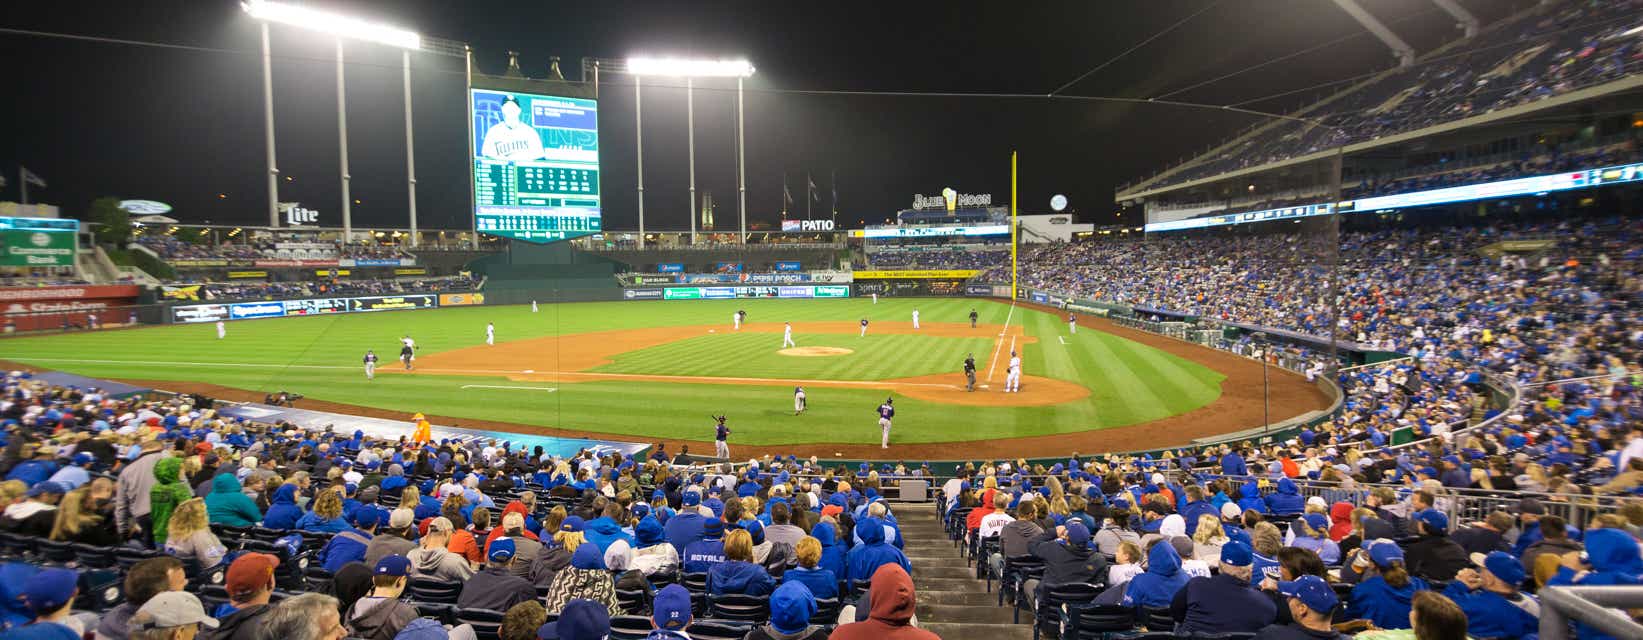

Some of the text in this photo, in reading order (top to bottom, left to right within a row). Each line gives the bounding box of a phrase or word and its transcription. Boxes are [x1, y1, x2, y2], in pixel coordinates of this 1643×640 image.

[494, 140, 529, 157] Twins
[287, 207, 319, 225] Lite
[801, 220, 834, 231] PATIO
[858, 284, 882, 293] Sprint
[988, 519, 1009, 528] HUNTE
[690, 554, 726, 563] ROYALS
